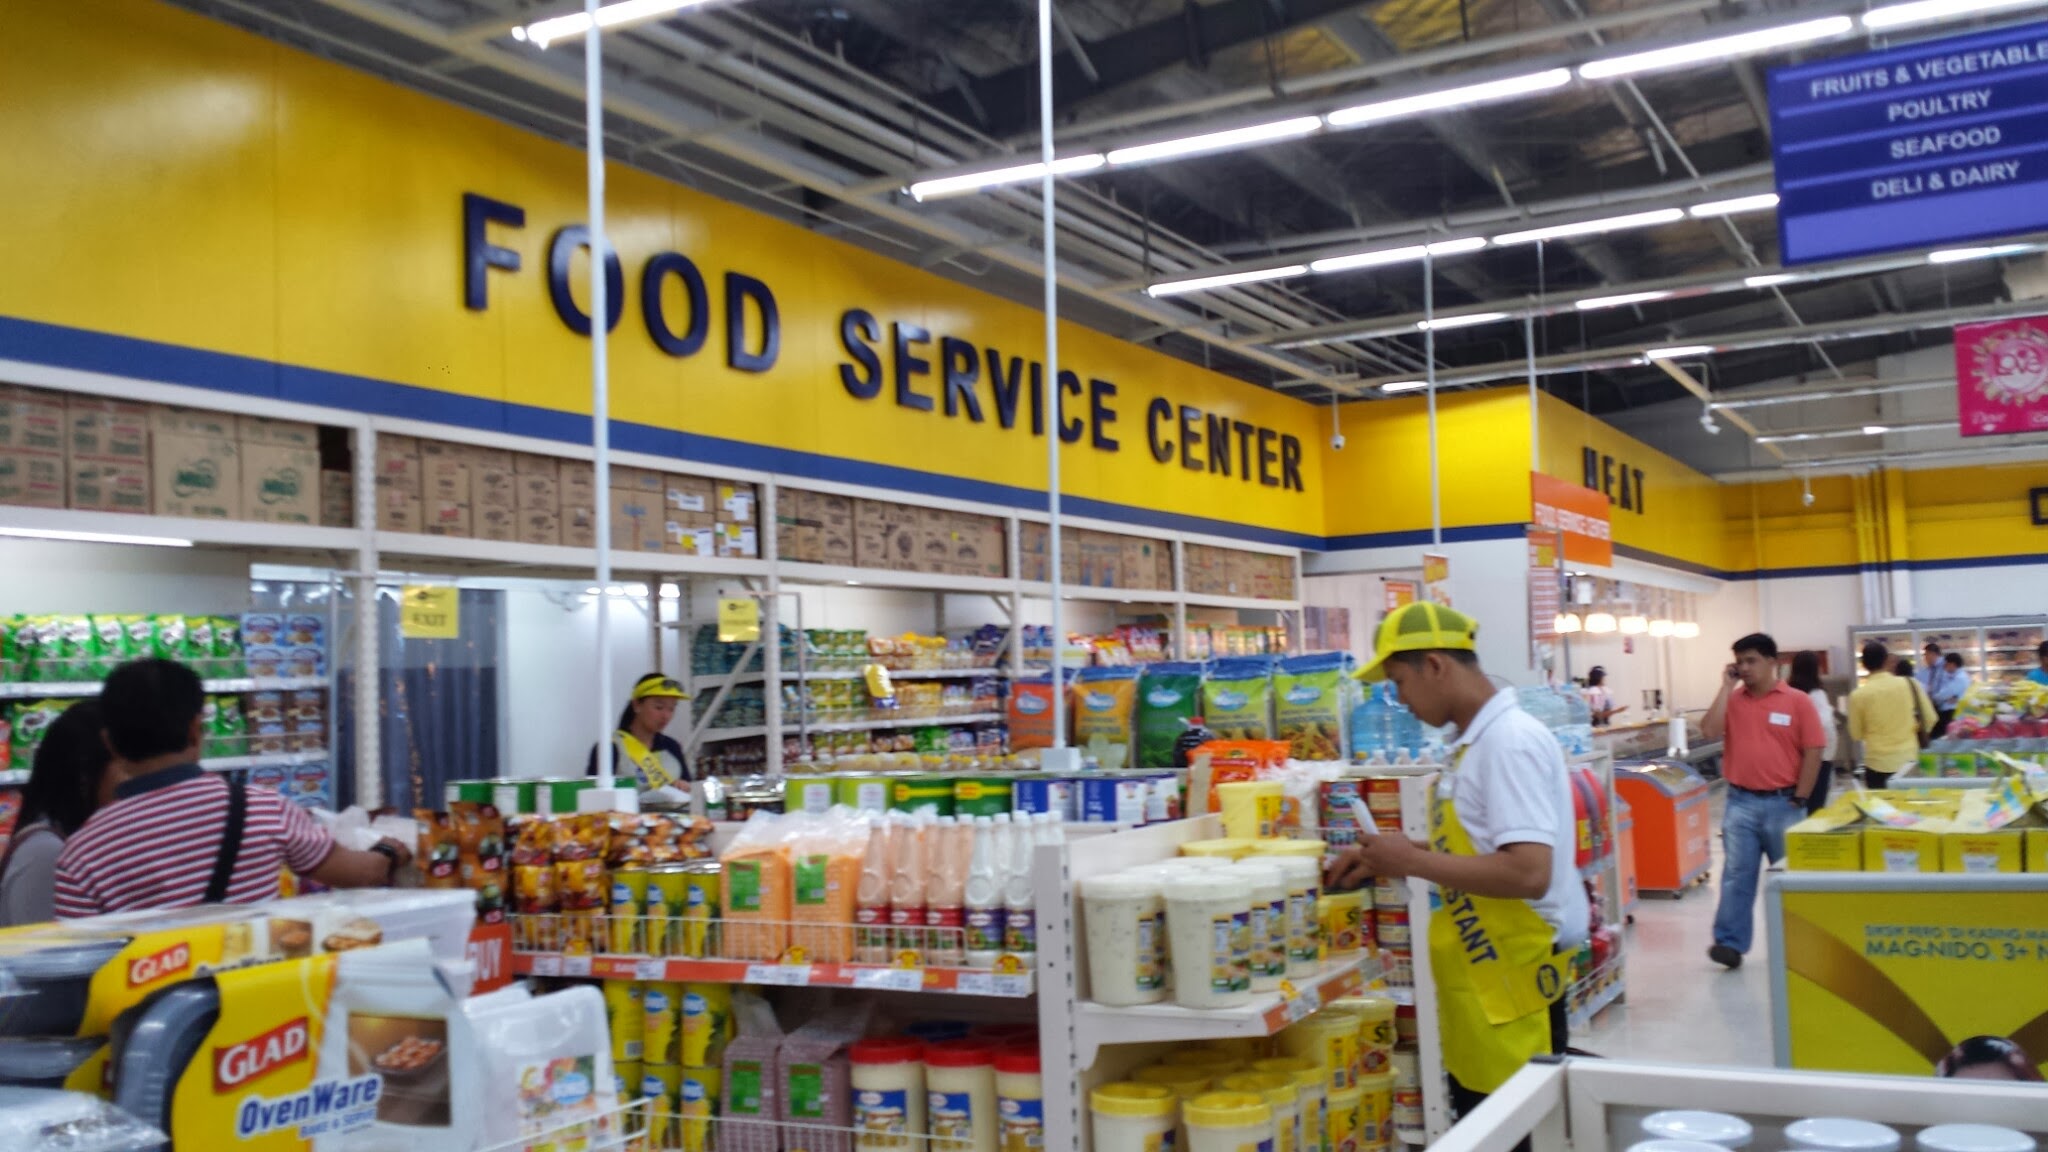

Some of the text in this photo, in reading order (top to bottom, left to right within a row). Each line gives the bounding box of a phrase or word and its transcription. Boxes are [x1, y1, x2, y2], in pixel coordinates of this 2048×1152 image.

[1811, 69, 1889, 98] FRUITS
[1895, 66, 1911, 84] &
[1888, 89, 1992, 122] POULTRY
[1890, 126, 2001, 159] SEAFOOD
[1872, 161, 2020, 199] DELI & DAIRY
[462, 191, 1304, 492] FOOD SERVICE CENTER
[1582, 446, 1644, 515] MEAT
[130, 947, 188, 984] GLAD
[2003, 942, 2028, 960] 3+
[219, 1026, 305, 1084] GLAD
[239, 1078, 378, 1134] OvenWare
